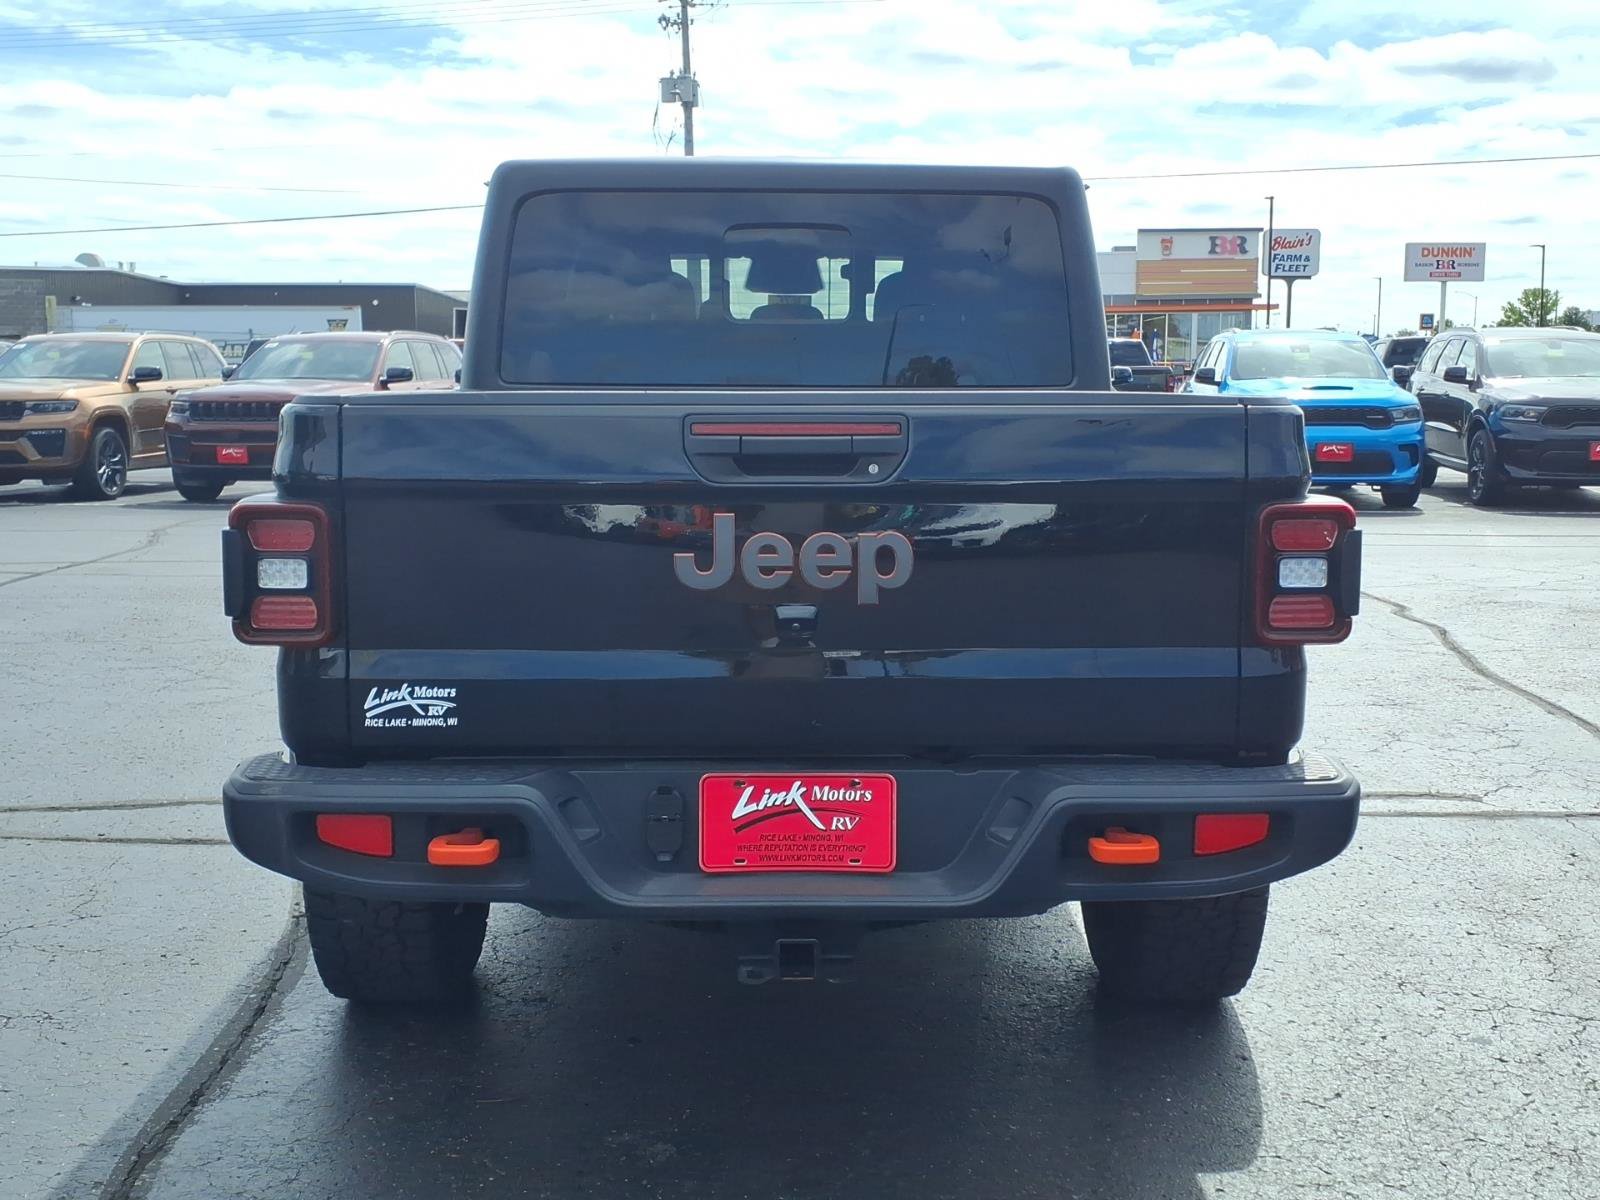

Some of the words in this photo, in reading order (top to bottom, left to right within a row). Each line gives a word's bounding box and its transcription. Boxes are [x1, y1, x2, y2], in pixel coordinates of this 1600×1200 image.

[1271, 232, 1313, 252] Blain's
[1272, 253, 1302, 263] FARM
[1303, 254, 1311, 263] &
[1274, 263, 1309, 274] FLEET
[673, 512, 914, 605] Jeep
[364, 683, 426, 716] Link
[413, 686, 457, 698] Motors
[427, 706, 448, 716] RV
[364, 718, 385, 727] RICE
[385, 718, 407, 727] LAKE
[447, 717, 458, 726] WI
[731, 780, 827, 831] Link
[811, 785, 873, 803] Motors
[830, 816, 861, 831] RV
[759, 834, 777, 842] RICE
[777, 834, 798, 842] LAKE
[834, 833, 844, 842] WI
[763, 844, 809, 852] REPUTATION
[809, 844, 817, 852] IS
